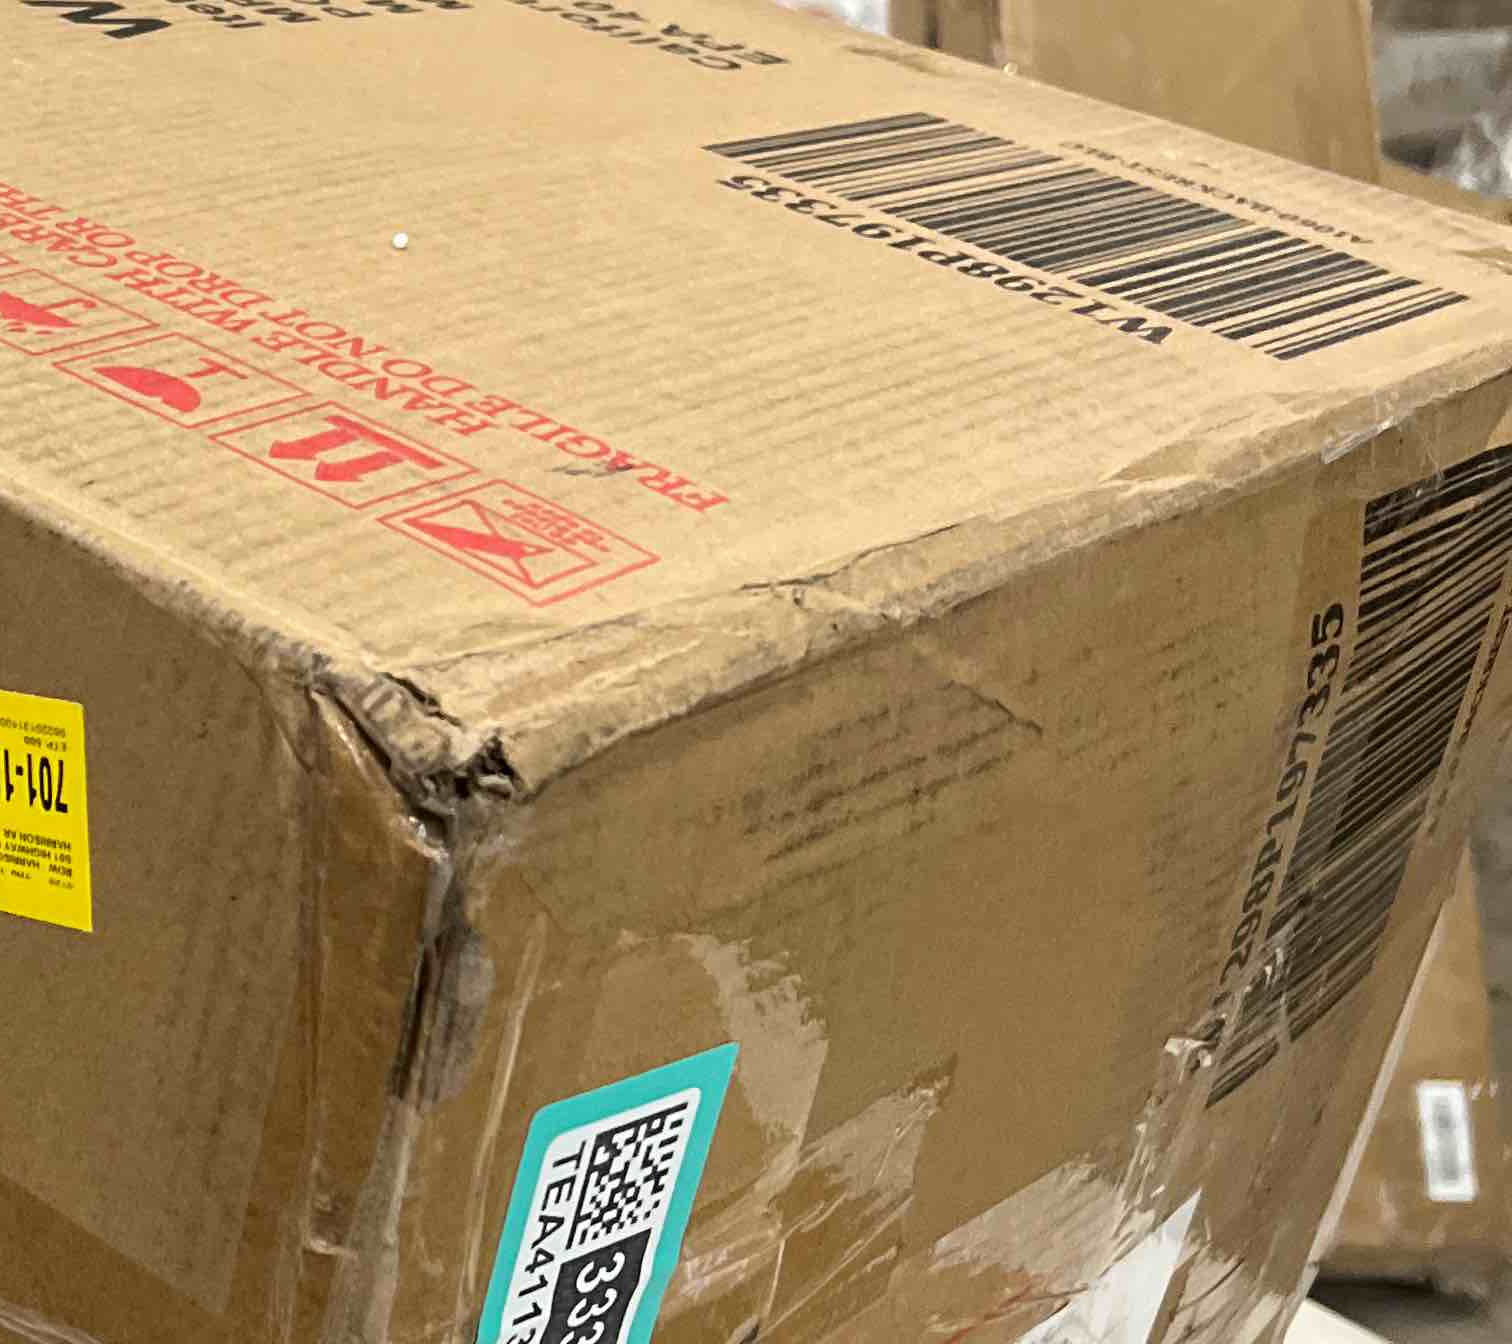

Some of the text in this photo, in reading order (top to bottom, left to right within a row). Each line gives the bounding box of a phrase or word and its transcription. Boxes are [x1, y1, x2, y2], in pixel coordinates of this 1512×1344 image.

[635, 23, 804, 66] EPA
[45, 215, 143, 253] OR
[715, 172, 1175, 347] W1298P197335
[99, 265, 268, 334] WITH
[114, 245, 275, 310] DROP
[251, 305, 391, 361] NOT
[241, 327, 505, 437] HANDLE
[367, 356, 478, 398] DO
[454, 394, 741, 513] FRAGILE
[1188, 601, 1346, 1050] 298P197335
